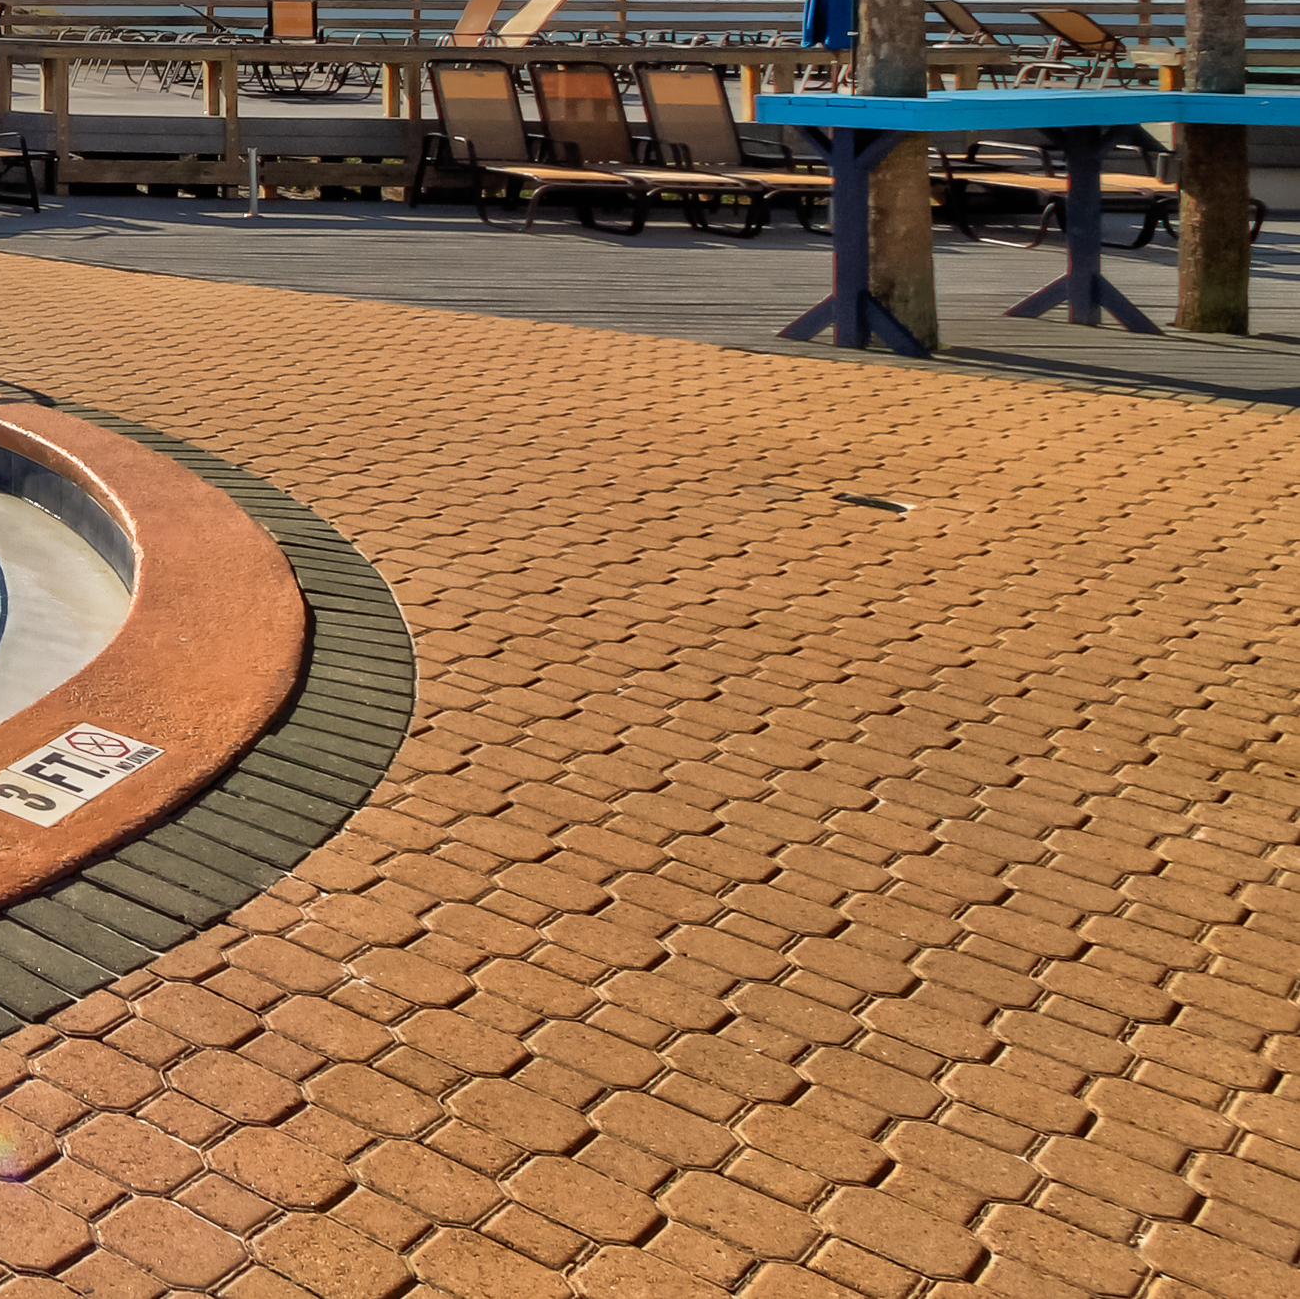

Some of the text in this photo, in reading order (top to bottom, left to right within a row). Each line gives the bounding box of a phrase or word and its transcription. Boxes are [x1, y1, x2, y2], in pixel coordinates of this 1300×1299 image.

[22, 751, 111, 794] FT.
[114, 746, 160, 771] NO DIVING
